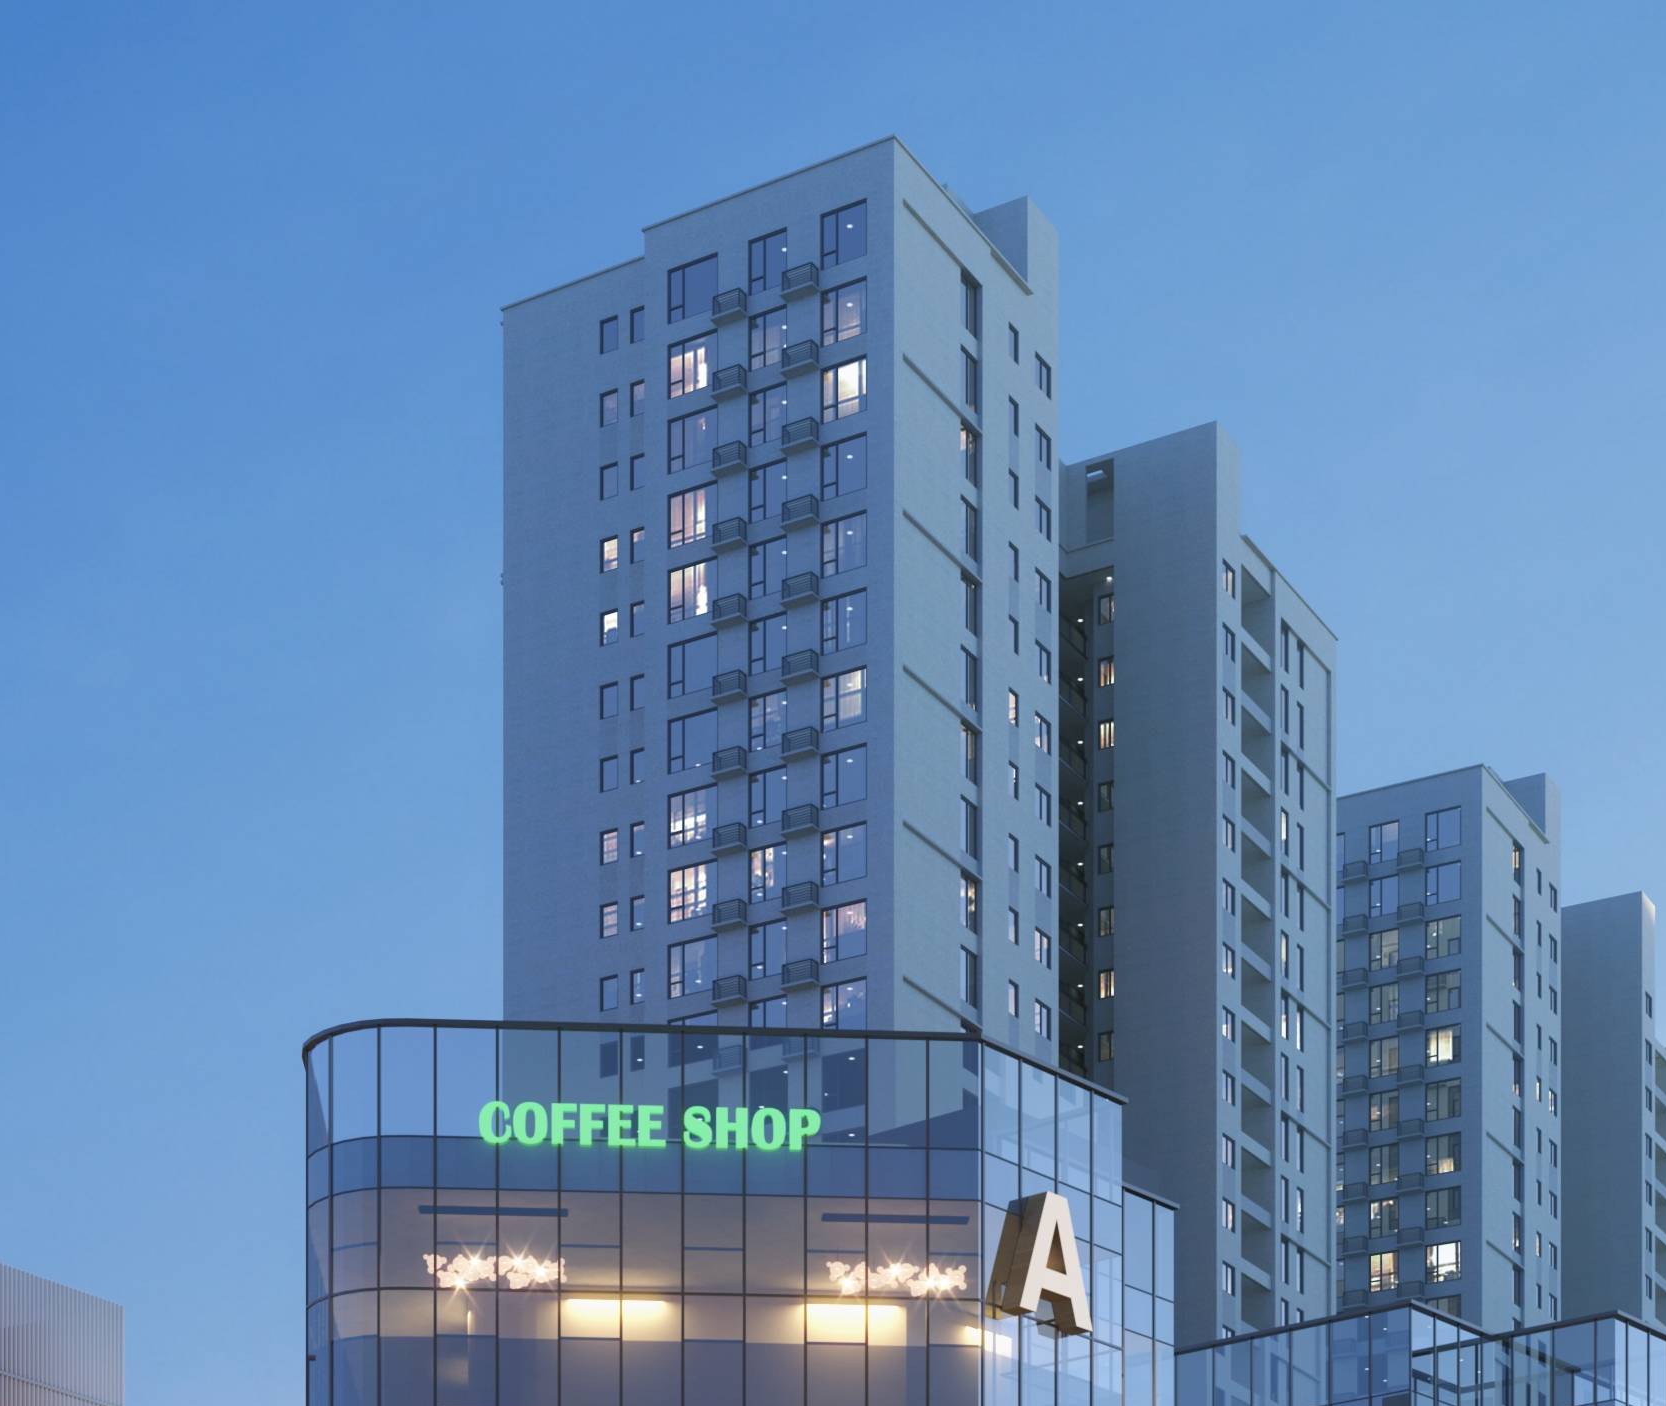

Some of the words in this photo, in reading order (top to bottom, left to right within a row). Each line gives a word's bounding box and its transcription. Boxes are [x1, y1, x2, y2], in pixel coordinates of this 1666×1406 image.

[478, 1100, 667, 1149] COFFEE
[683, 1105, 822, 1151] SHOP
[1003, 1190, 1093, 1334] A
